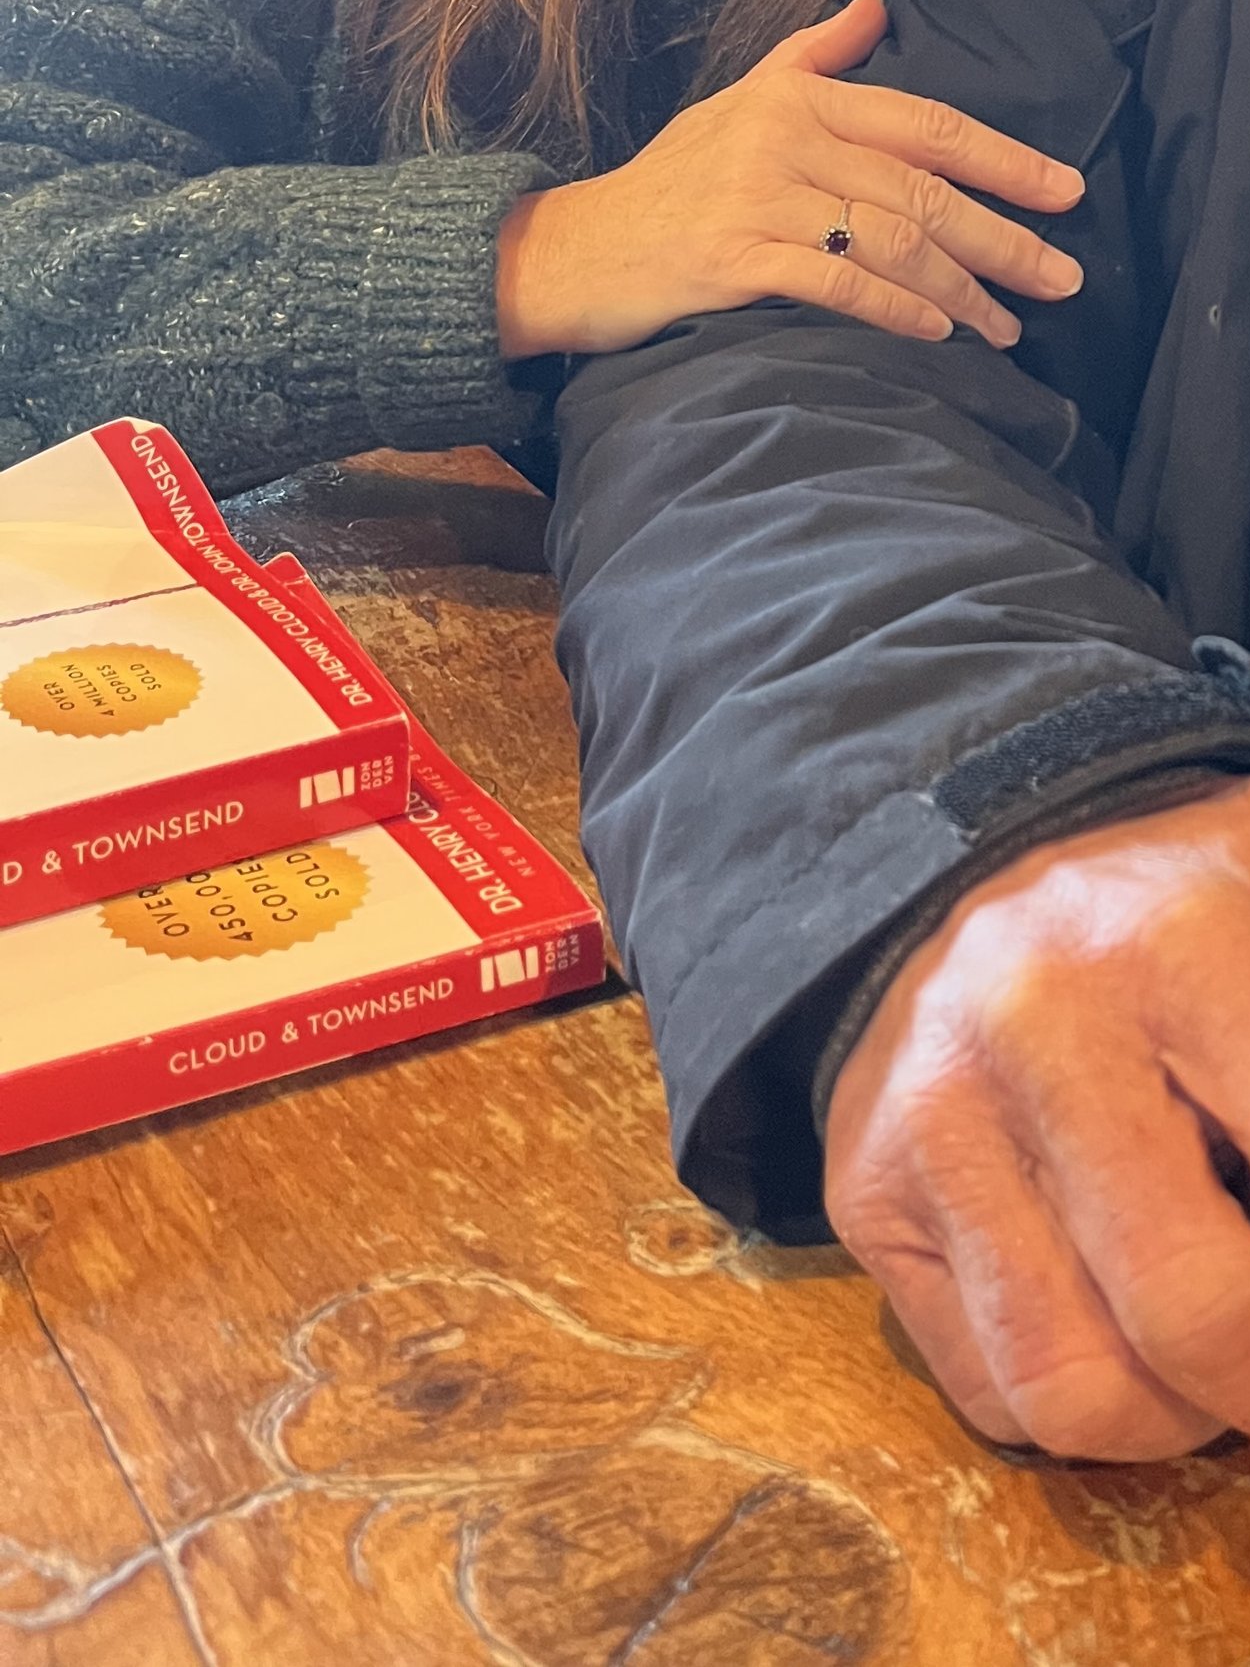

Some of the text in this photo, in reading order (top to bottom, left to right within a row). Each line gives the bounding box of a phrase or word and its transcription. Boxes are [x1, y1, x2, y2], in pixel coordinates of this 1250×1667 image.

[130, 433, 374, 707] DR. HENRY CLOUD & DR. JOHN TOWNSEND
[43, 681, 76, 712] OVER
[62, 663, 108, 708] MILLION
[96, 664, 138, 703] COPIES
[129, 663, 163, 691] SOLD
[360, 761, 371, 791] ZON
[384, 755, 394, 784] VAN
[41, 850, 63, 875] &
[72, 801, 245, 866] TOWNSEND
[417, 766, 536, 878] NEW YORK TIMES
[285, 851, 340, 900] SOLD
[419, 822, 495, 882] HENRY
[138, 884, 190, 937] OVER
[479, 878, 524, 915] DR.
[168, 978, 455, 1075] CLOUD & TOWNSEND
